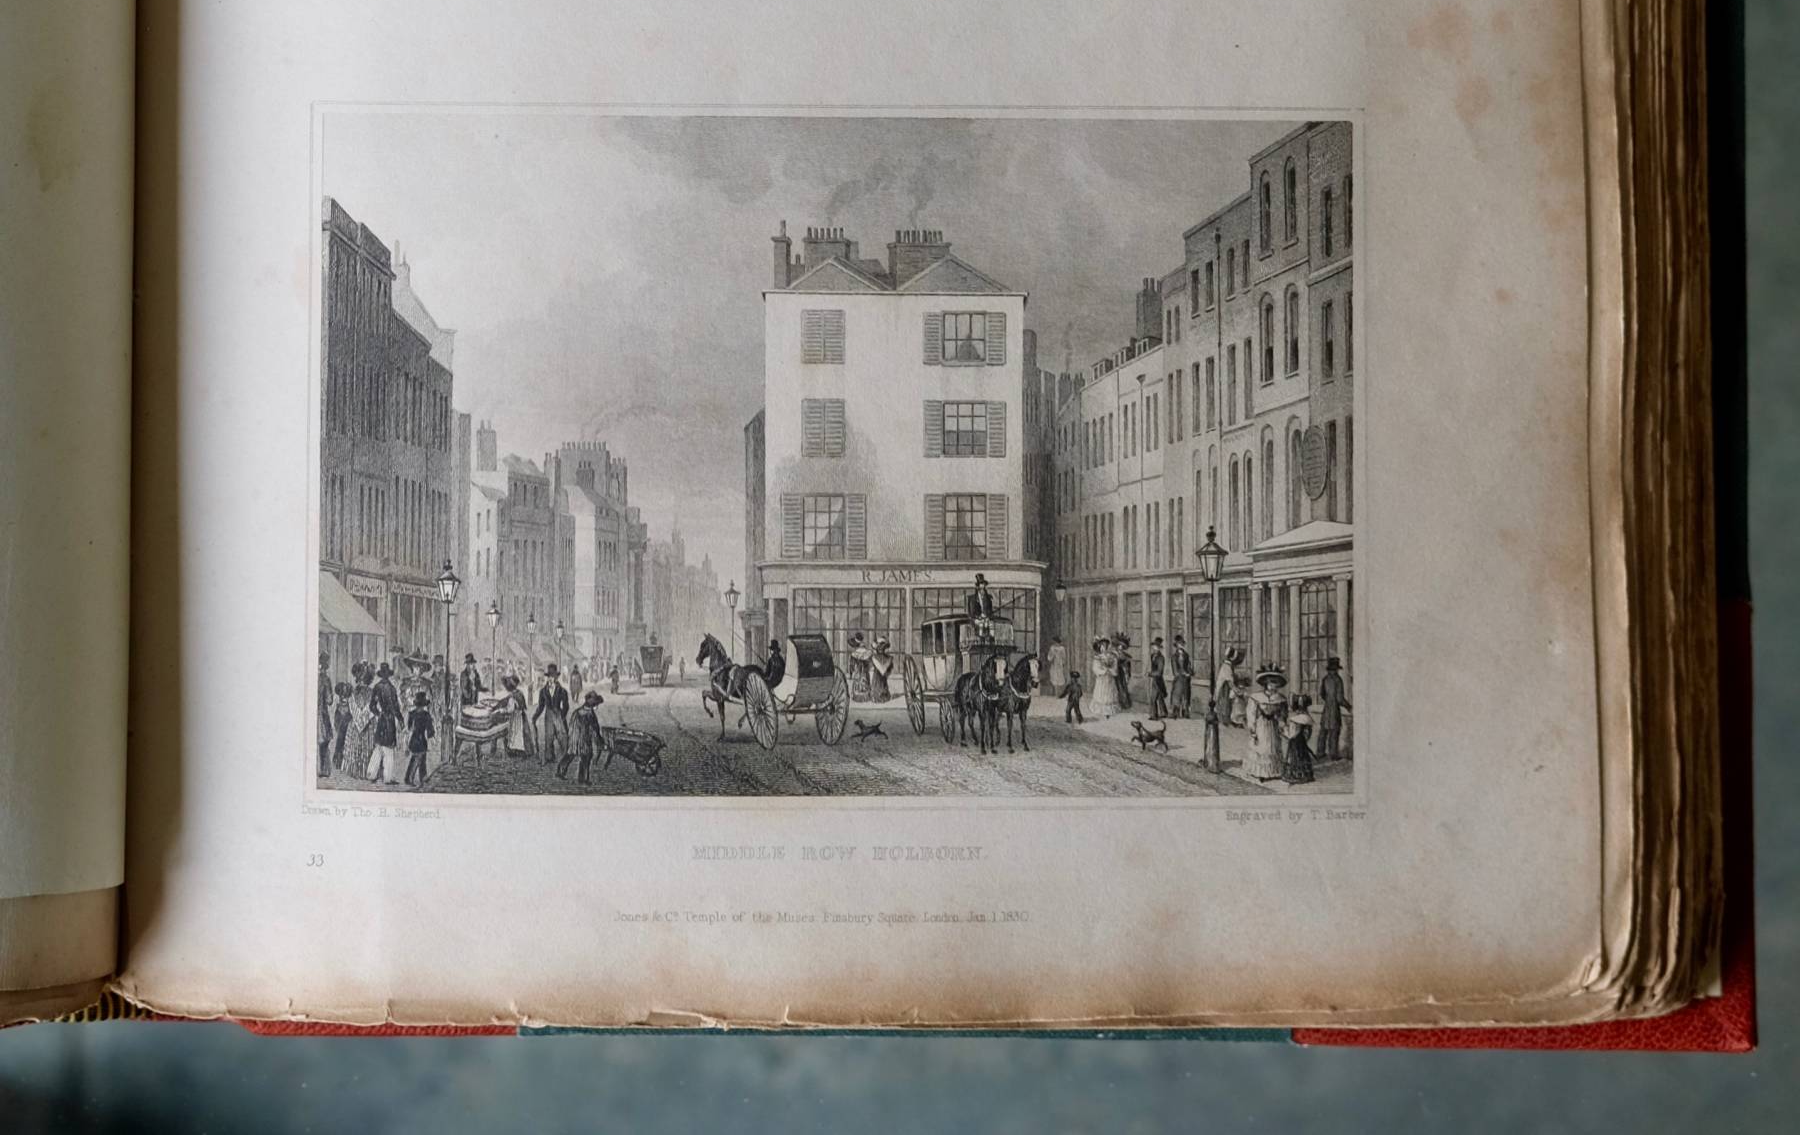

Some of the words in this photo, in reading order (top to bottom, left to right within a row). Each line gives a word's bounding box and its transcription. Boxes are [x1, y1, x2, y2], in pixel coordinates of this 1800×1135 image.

[334, 806, 348, 818] by
[1226, 809, 1281, 826] Engraved
[1288, 809, 1303, 824] by
[1326, 809, 1366, 820] Barber
[306, 853, 325, 867] 33
[692, 845, 785, 860] MIDDLE
[801, 846, 856, 860] ROW
[613, 911, 648, 922] Jones
[683, 911, 726, 926] Temple
[731, 911, 745, 922] of
[752, 911, 772, 923] the
[823, 912, 873, 927] Finsbury
